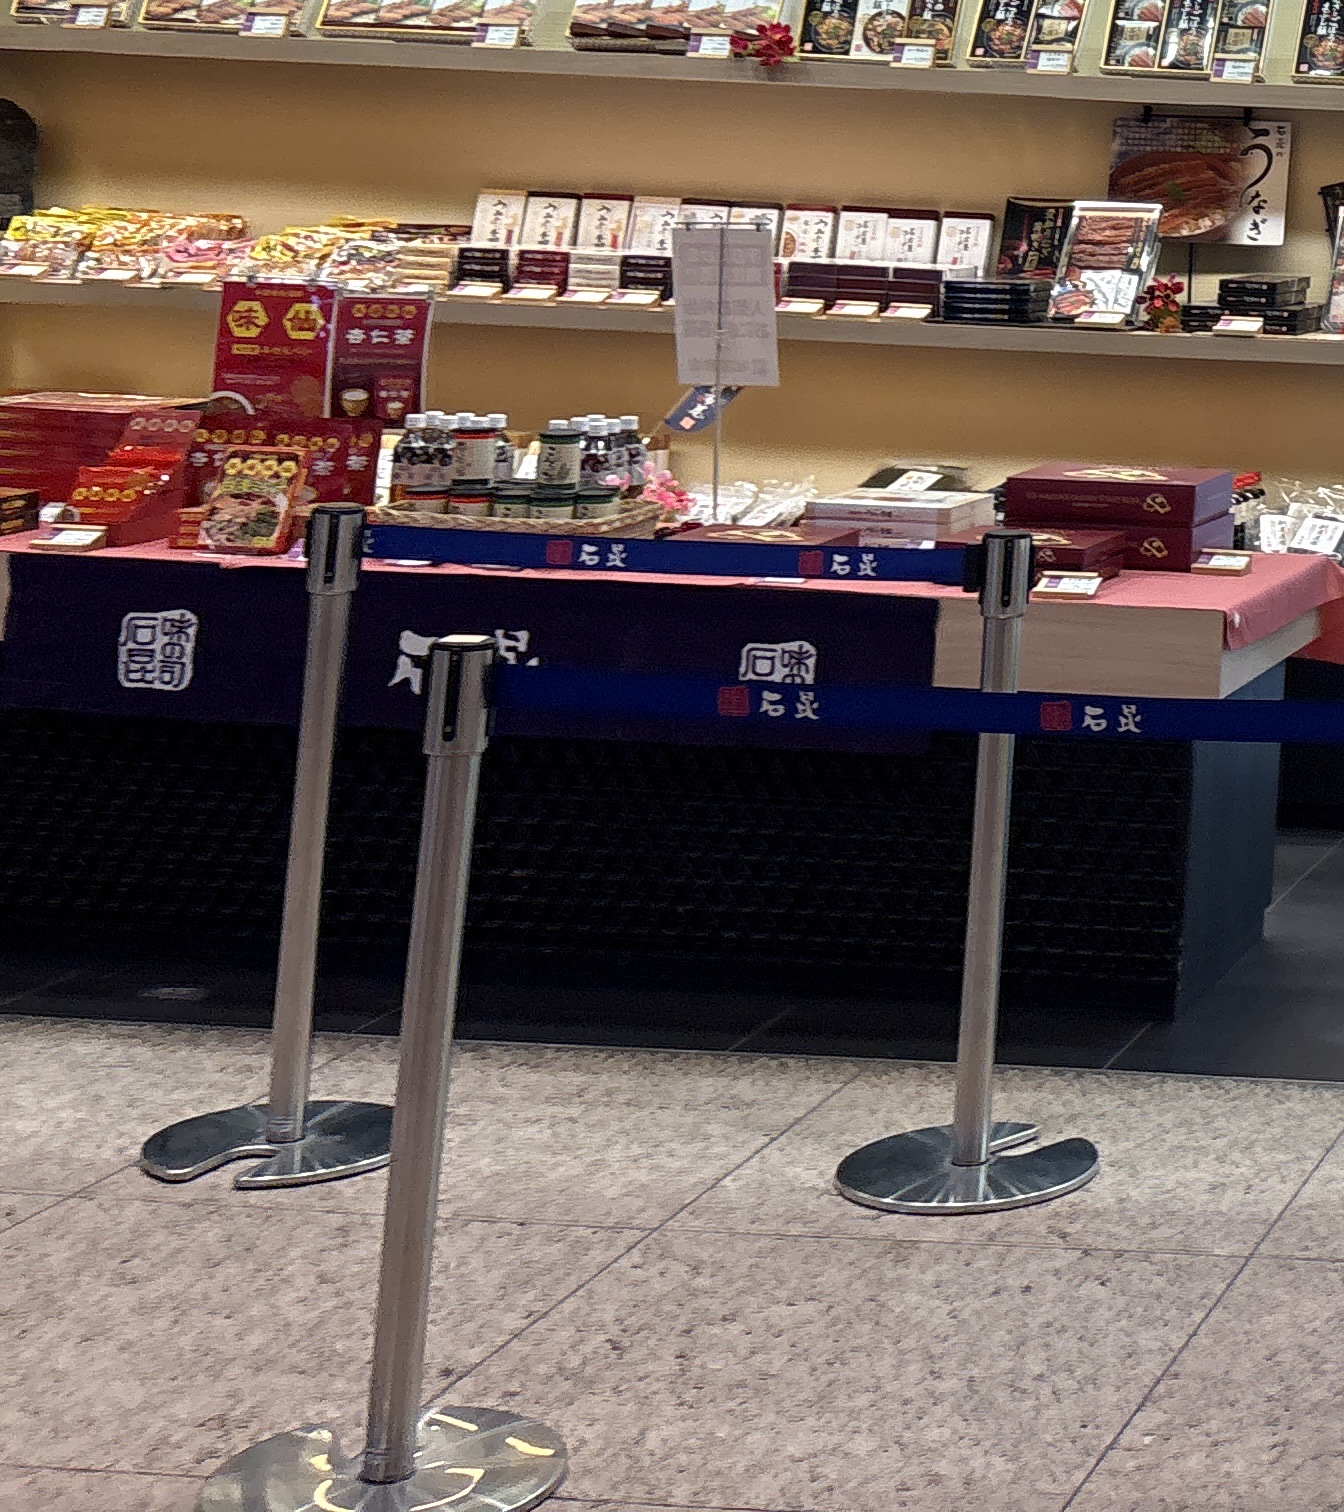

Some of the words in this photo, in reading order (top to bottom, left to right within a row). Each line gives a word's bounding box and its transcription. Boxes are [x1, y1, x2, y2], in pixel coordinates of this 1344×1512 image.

[1238, 127, 1273, 241] うなぎ
[578, 544, 628, 568] 石昆
[829, 553, 878, 576] 石昆
[759, 690, 820, 721] 石昆
[1081, 704, 1146, 734] 石昆
